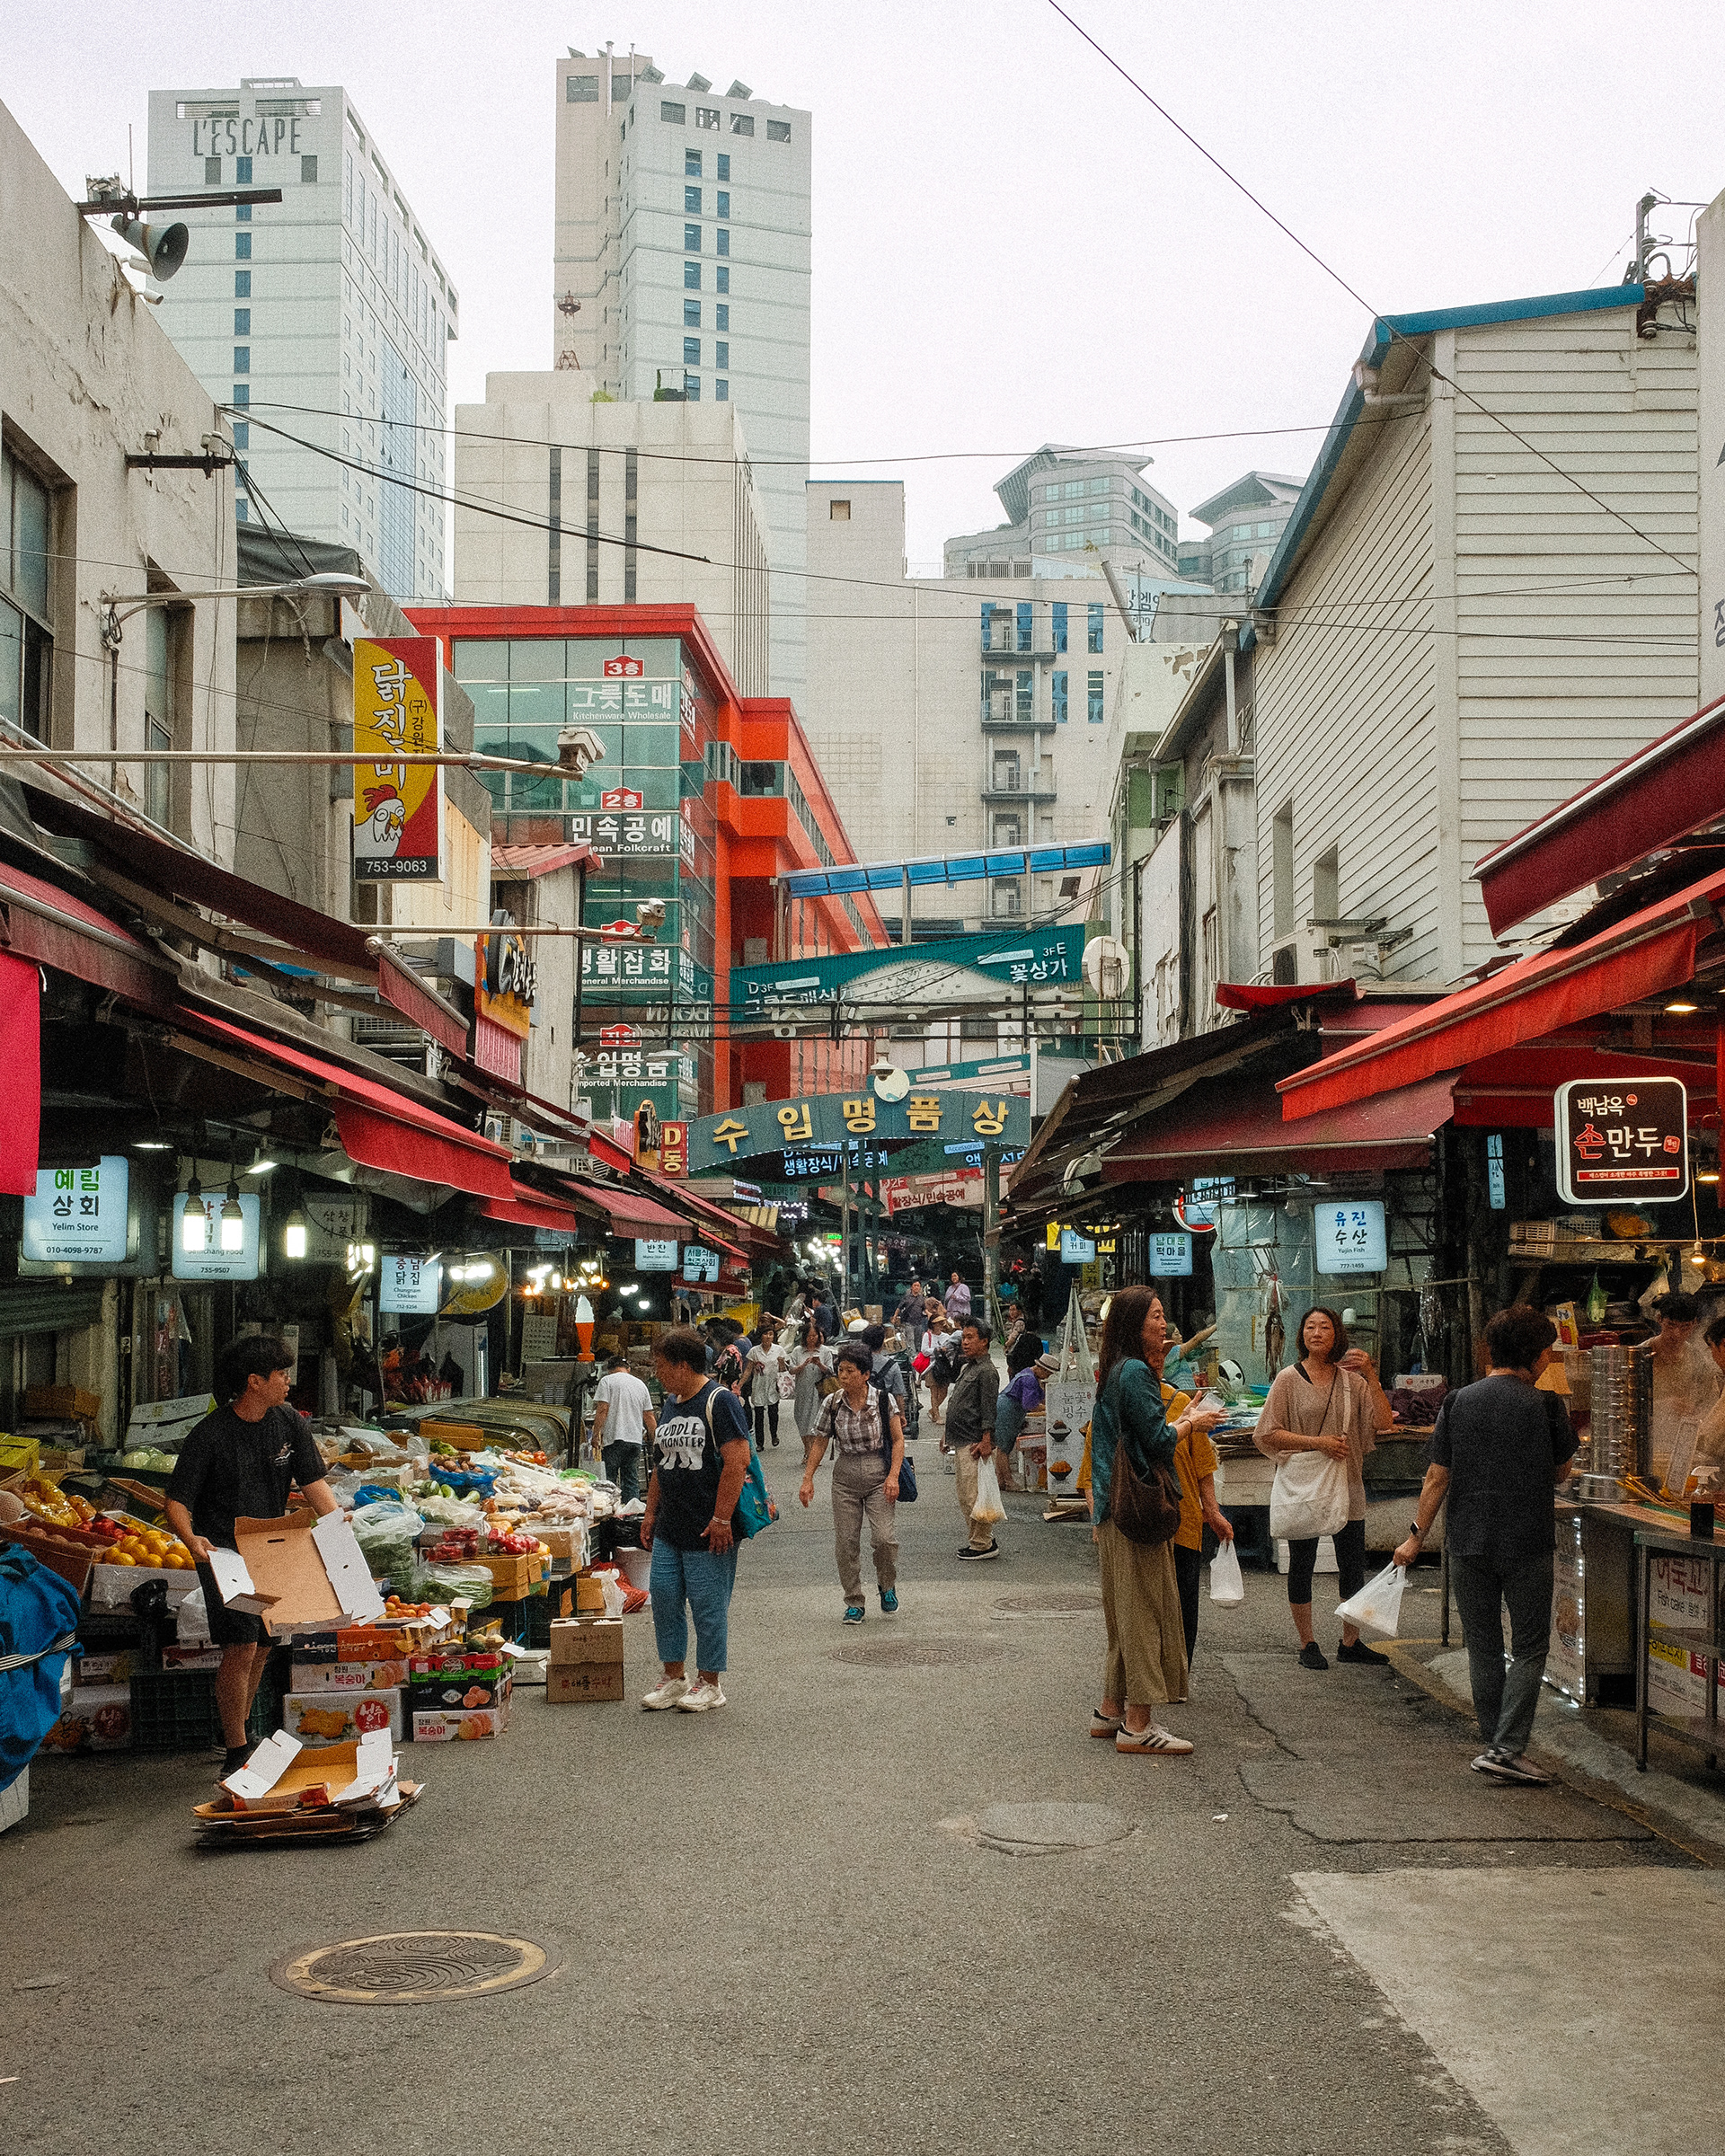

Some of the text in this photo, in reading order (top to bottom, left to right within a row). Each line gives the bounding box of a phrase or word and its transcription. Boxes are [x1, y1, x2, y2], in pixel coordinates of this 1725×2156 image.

[193, 118, 301, 155] L'ESCAPE
[607, 662, 640, 675] 3층
[572, 683, 672, 710] 그릇도매
[573, 711, 671, 720] Kitchenware Wholesale
[606, 794, 639, 808] 2층
[571, 816, 671, 843] 민속공예
[617, 844, 671, 853] Folkcraft
[366, 861, 427, 873] 753-9063
[1010, 958, 1067, 983] 꽃상가
[582, 976, 669, 985] eneral Merchandise
[748, 982, 759, 994] D
[578, 1079, 668, 1088] mported Merchandise
[1577, 1095, 1625, 1118] 백남옥
[1574, 1123, 1662, 1160] 손만두
[55, 1170, 100, 1191] 예림
[53, 1195, 100, 1216] 상회
[1335, 1211, 1367, 1226] 유진
[52, 1223, 99, 1231] Yelim Store
[1335, 1229, 1367, 1245] 수산
[395, 1272, 420, 1286] 닭집
[1063, 1406, 1087, 1419] 빙수
[657, 1422, 699, 1437] CUDDLE
[660, 1437, 704, 1448] MONSTER
[334, 1674, 365, 1684] 복숭아
[359, 1703, 385, 1724] 성주
[419, 1726, 445, 1735] 복숭아
